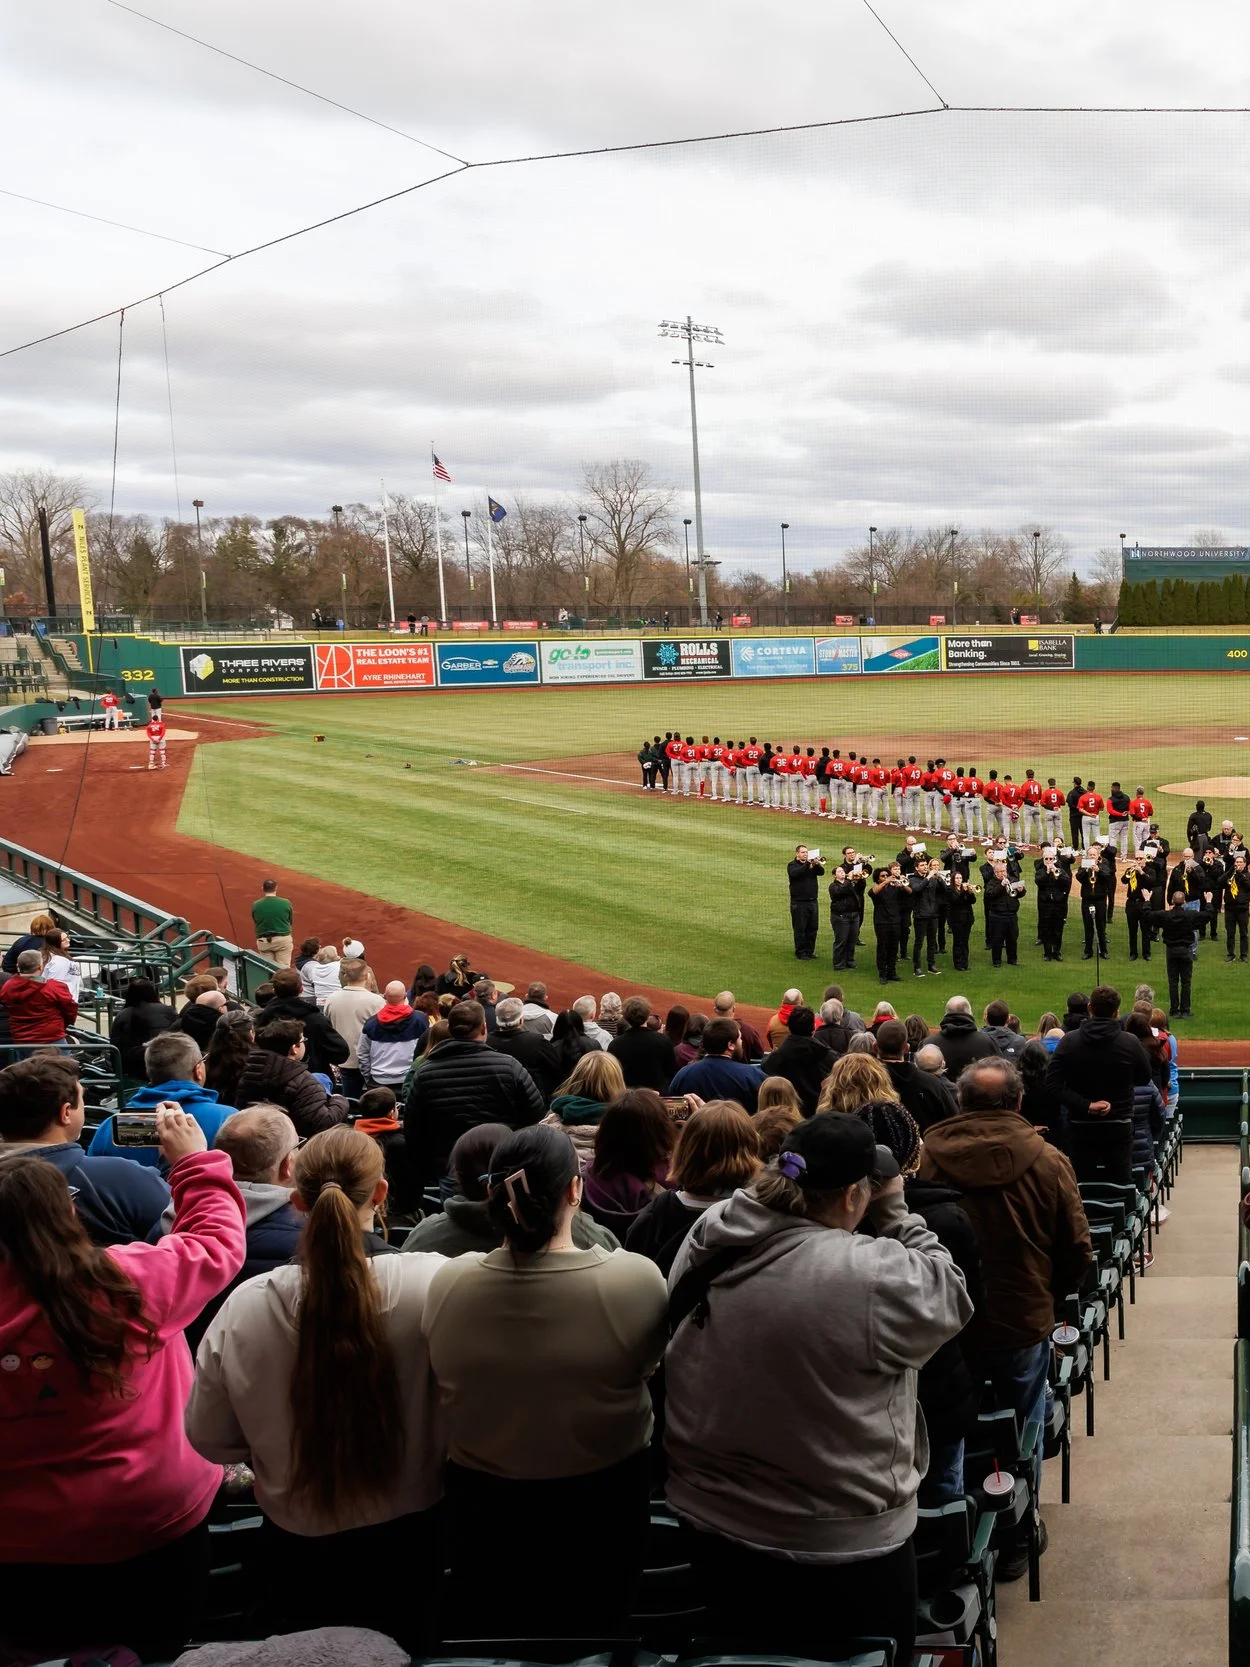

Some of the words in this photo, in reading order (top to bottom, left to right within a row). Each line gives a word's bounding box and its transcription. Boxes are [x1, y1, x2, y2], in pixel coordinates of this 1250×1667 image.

[356, 649, 377, 657] THE
[378, 648, 416, 657] LOON'S
[417, 647, 430, 655] #1
[680, 643, 718, 656] ROLLS
[757, 646, 806, 655] CORTEVA
[949, 650, 987, 659] Banking.
[219, 660, 259, 668] THREE
[261, 659, 305, 667] RIVERS
[441, 660, 482, 670] GARBER
[557, 660, 612, 671] transport
[122, 670, 155, 680] 332
[880, 771, 885, 779] 3
[911, 770, 920, 779] 43
[1089, 798, 1095, 808] 2
[1140, 803, 1145, 813] 5
